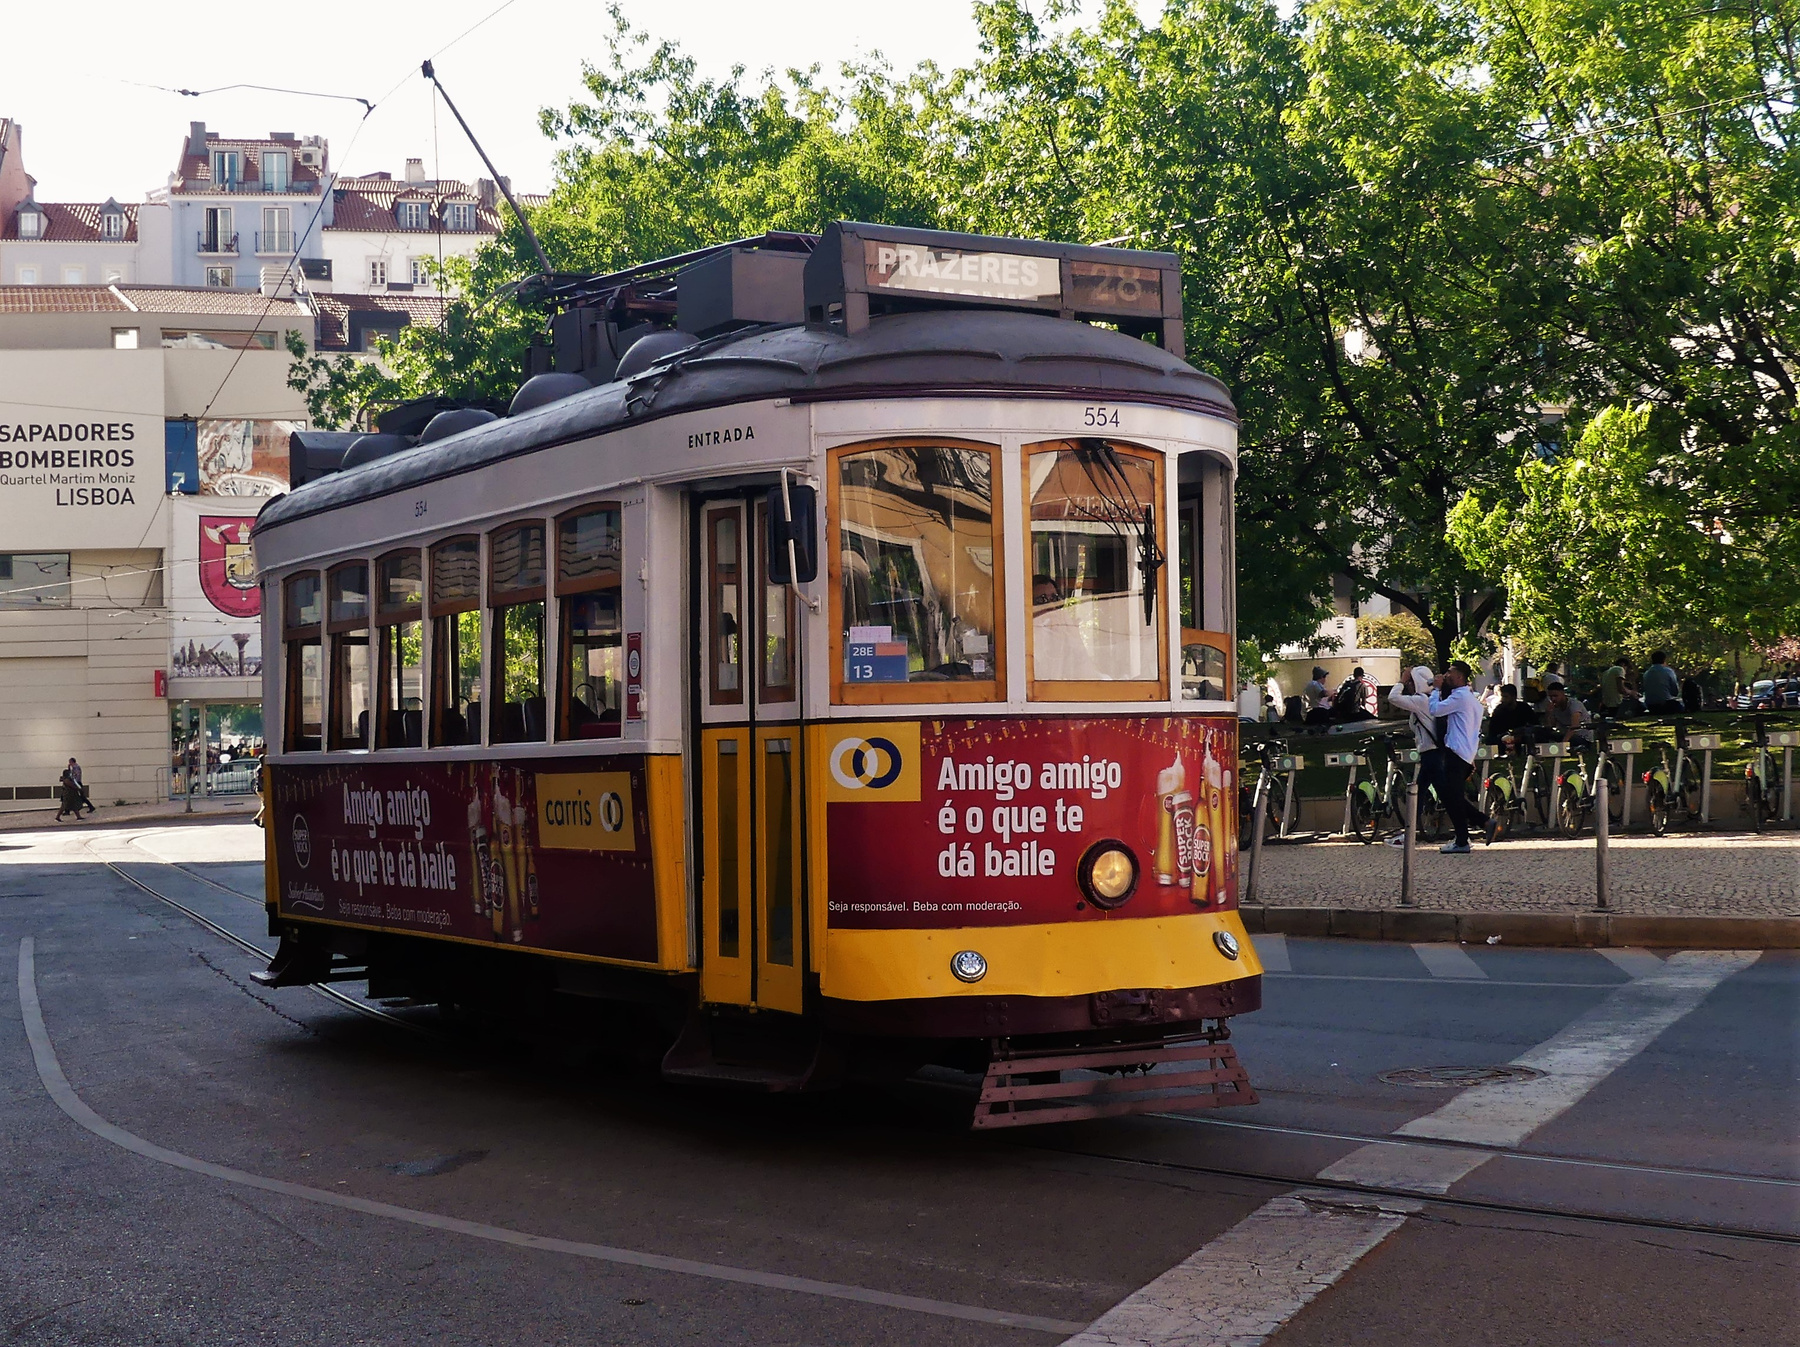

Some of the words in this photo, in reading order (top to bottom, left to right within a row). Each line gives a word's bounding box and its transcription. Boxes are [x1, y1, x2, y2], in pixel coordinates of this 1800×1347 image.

[878, 247, 1039, 287] PRAZERES
[1090, 263, 1142, 303] 28
[1083, 407, 1121, 429] 554
[0, 423, 135, 442] SAPADORES
[688, 425, 755, 449] ENTRADA
[0, 449, 135, 469] BOMBEIROS
[0, 474, 47, 486] Quartel
[50, 473, 95, 485] Martim
[99, 473, 136, 484] Moniz
[56, 488, 136, 506] LISBOA
[415, 501, 428, 518] 554
[852, 647, 874, 657] 28E
[853, 665, 873, 679] 13
[937, 755, 1031, 800] Amigo
[1039, 755, 1121, 799] amigo
[343, 781, 382, 839] Amigo
[386, 780, 431, 840] amigo
[545, 790, 592, 826] carris
[938, 800, 956, 834] é
[966, 808, 984, 834] o
[992, 807, 1046, 843] que
[1055, 799, 1084, 832] te
[1176, 817, 1188, 865] SUPER
[1193, 838, 1210, 851] SUPER
[331, 839, 340, 882] é
[342, 849, 351, 882] o
[353, 848, 378, 897] que
[380, 851, 396, 887] te
[398, 842, 416, 887] dá
[419, 841, 457, 891] baile
[938, 840, 975, 878] dá
[984, 841, 1055, 877] baile
[386, 903, 401, 920] Beba
[403, 908, 415, 921] com
[828, 901, 849, 914] Seja
[851, 901, 909, 914] responsável.
[913, 901, 938, 912] Beba
[941, 903, 962, 912] com
[966, 900, 1022, 913] moderação.
